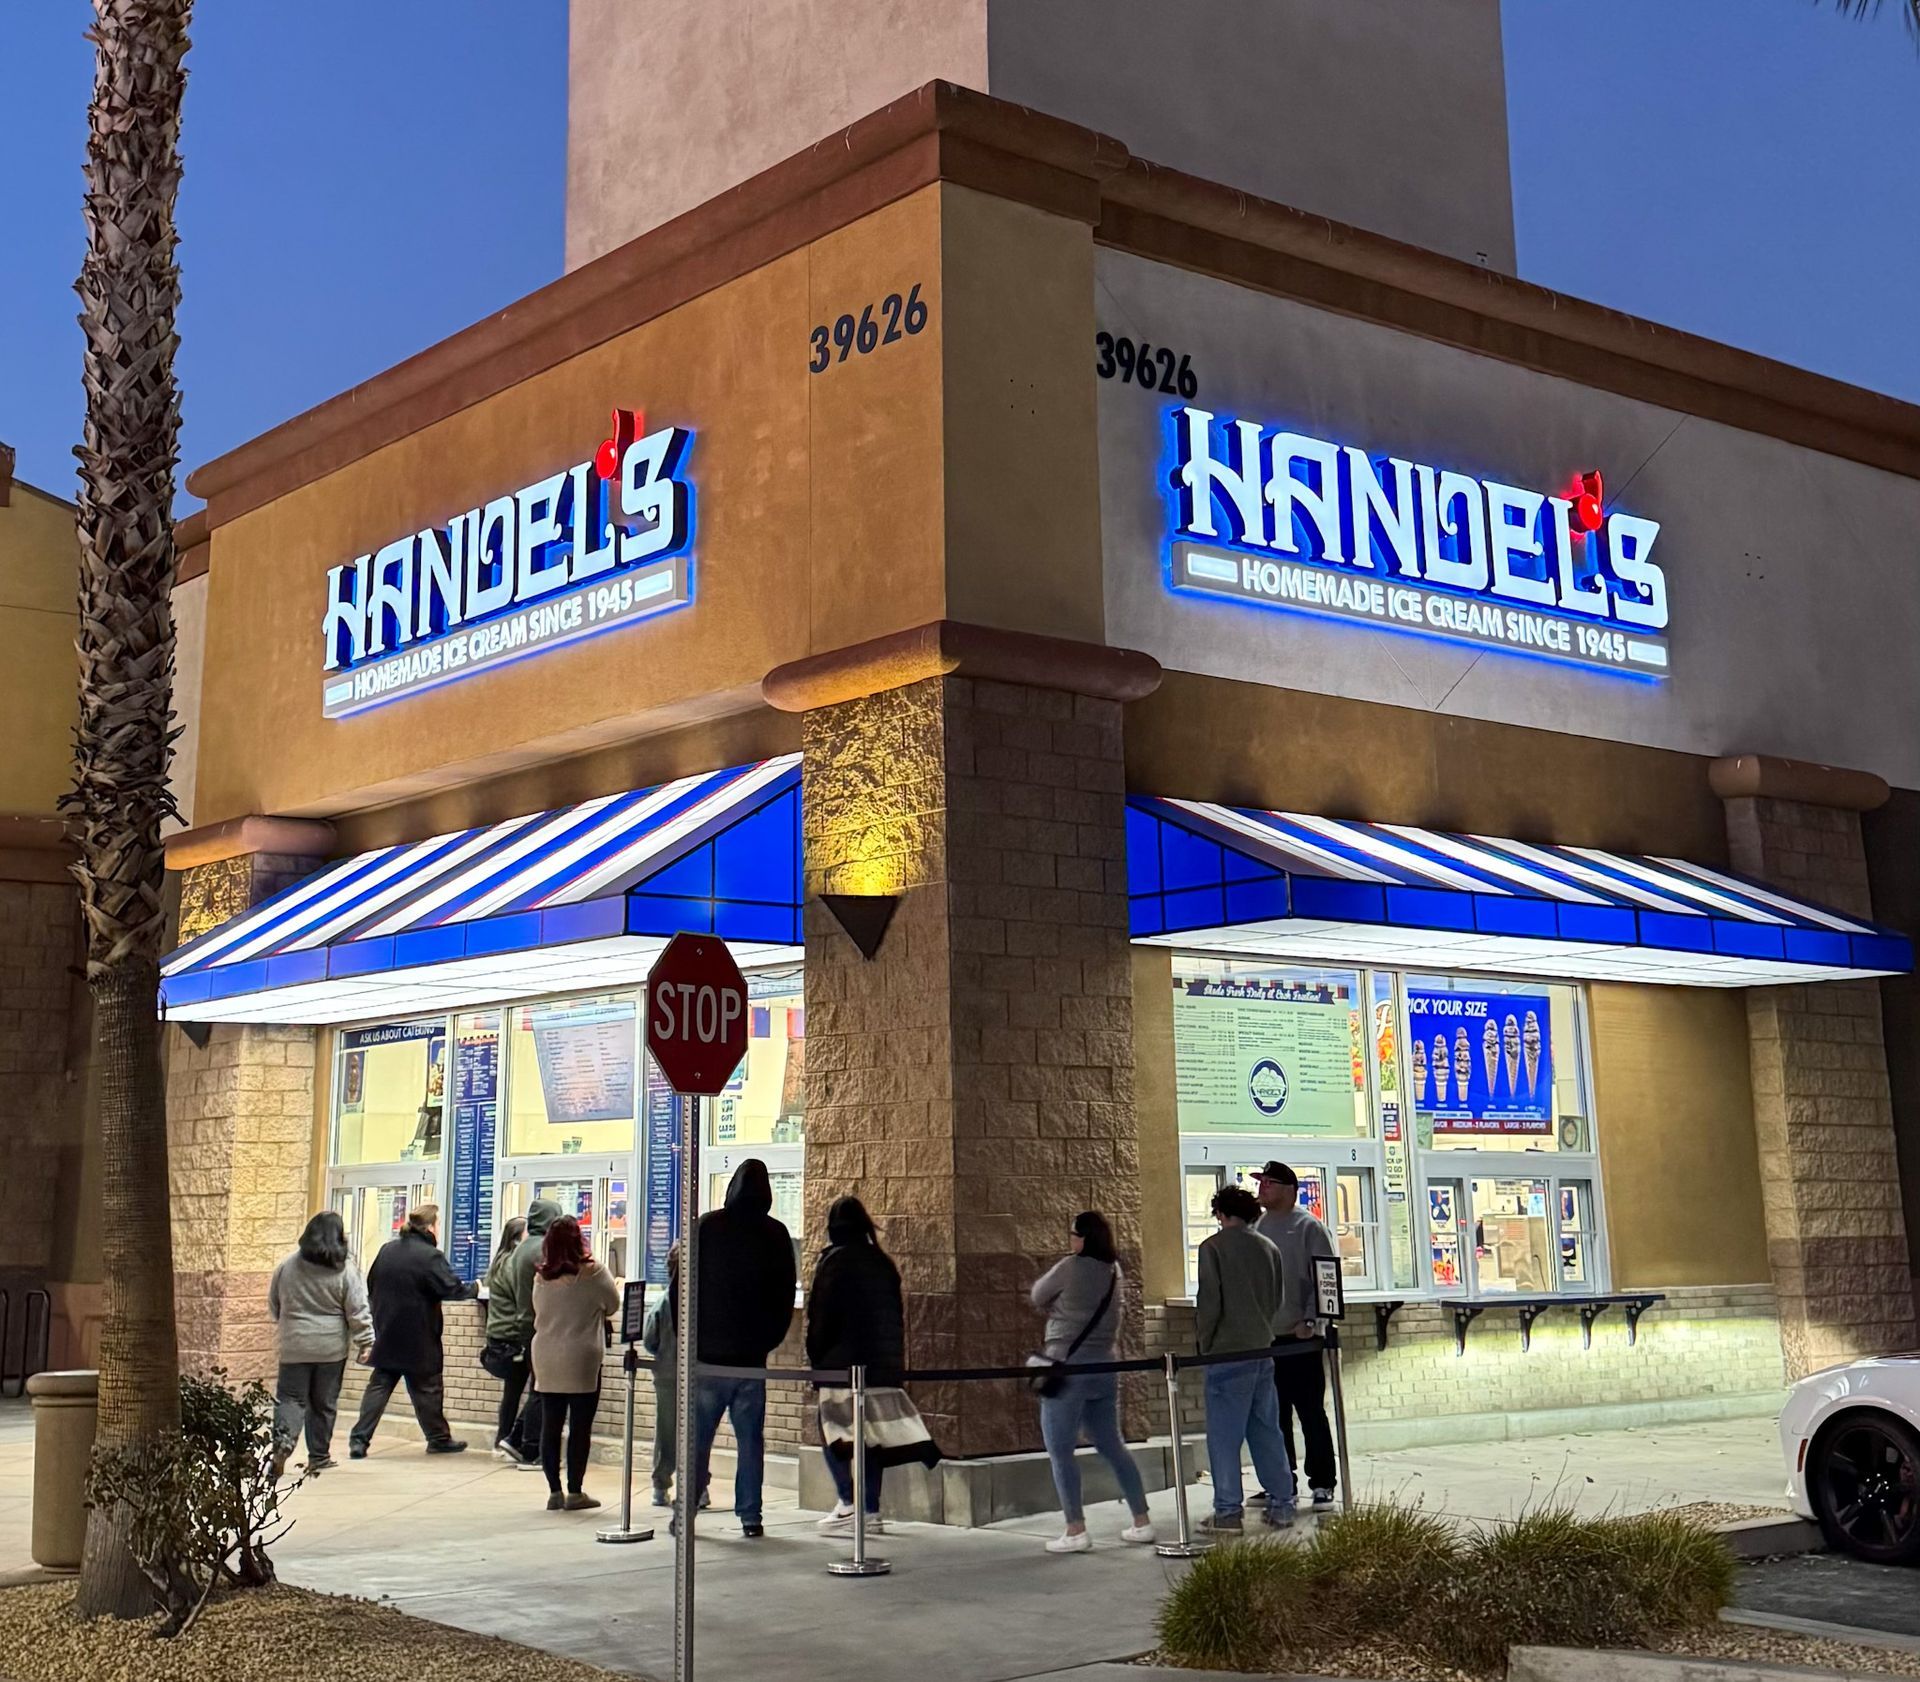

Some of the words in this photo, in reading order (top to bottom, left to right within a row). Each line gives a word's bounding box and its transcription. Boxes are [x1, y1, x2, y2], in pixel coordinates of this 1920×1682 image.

[809, 283, 928, 373] 39626
[1096, 331, 1198, 399] 39626
[323, 409, 687, 671] HANDEL'S
[1180, 406, 1668, 629] HANDEL'S
[354, 645, 442, 700] HOMEMADE
[443, 635, 468, 669] ICE
[469, 619, 527, 660] CREAM
[529, 599, 582, 640] SINCE
[587, 579, 634, 622] 1945
[1242, 558, 1384, 616] HOMEMADE
[1388, 589, 1423, 623] ICE
[1425, 597, 1504, 638] CREAM
[1506, 613, 1571, 651] SINCE
[1575, 625, 1627, 662] 1945
[359, 1033, 373, 1044] ASK
[373, 1031, 381, 1042] US
[380, 1027, 402, 1041] ABOUT
[654, 981, 742, 1044] STOP
[1431, 998, 1463, 1016] YOUR
[1464, 1000, 1488, 1018] SIZE
[1203, 1146, 1209, 1160] 7
[1350, 1148, 1357, 1161] 8
[1322, 1272, 1335, 1280] LINE
[1322, 1289, 1337, 1297] HERE
